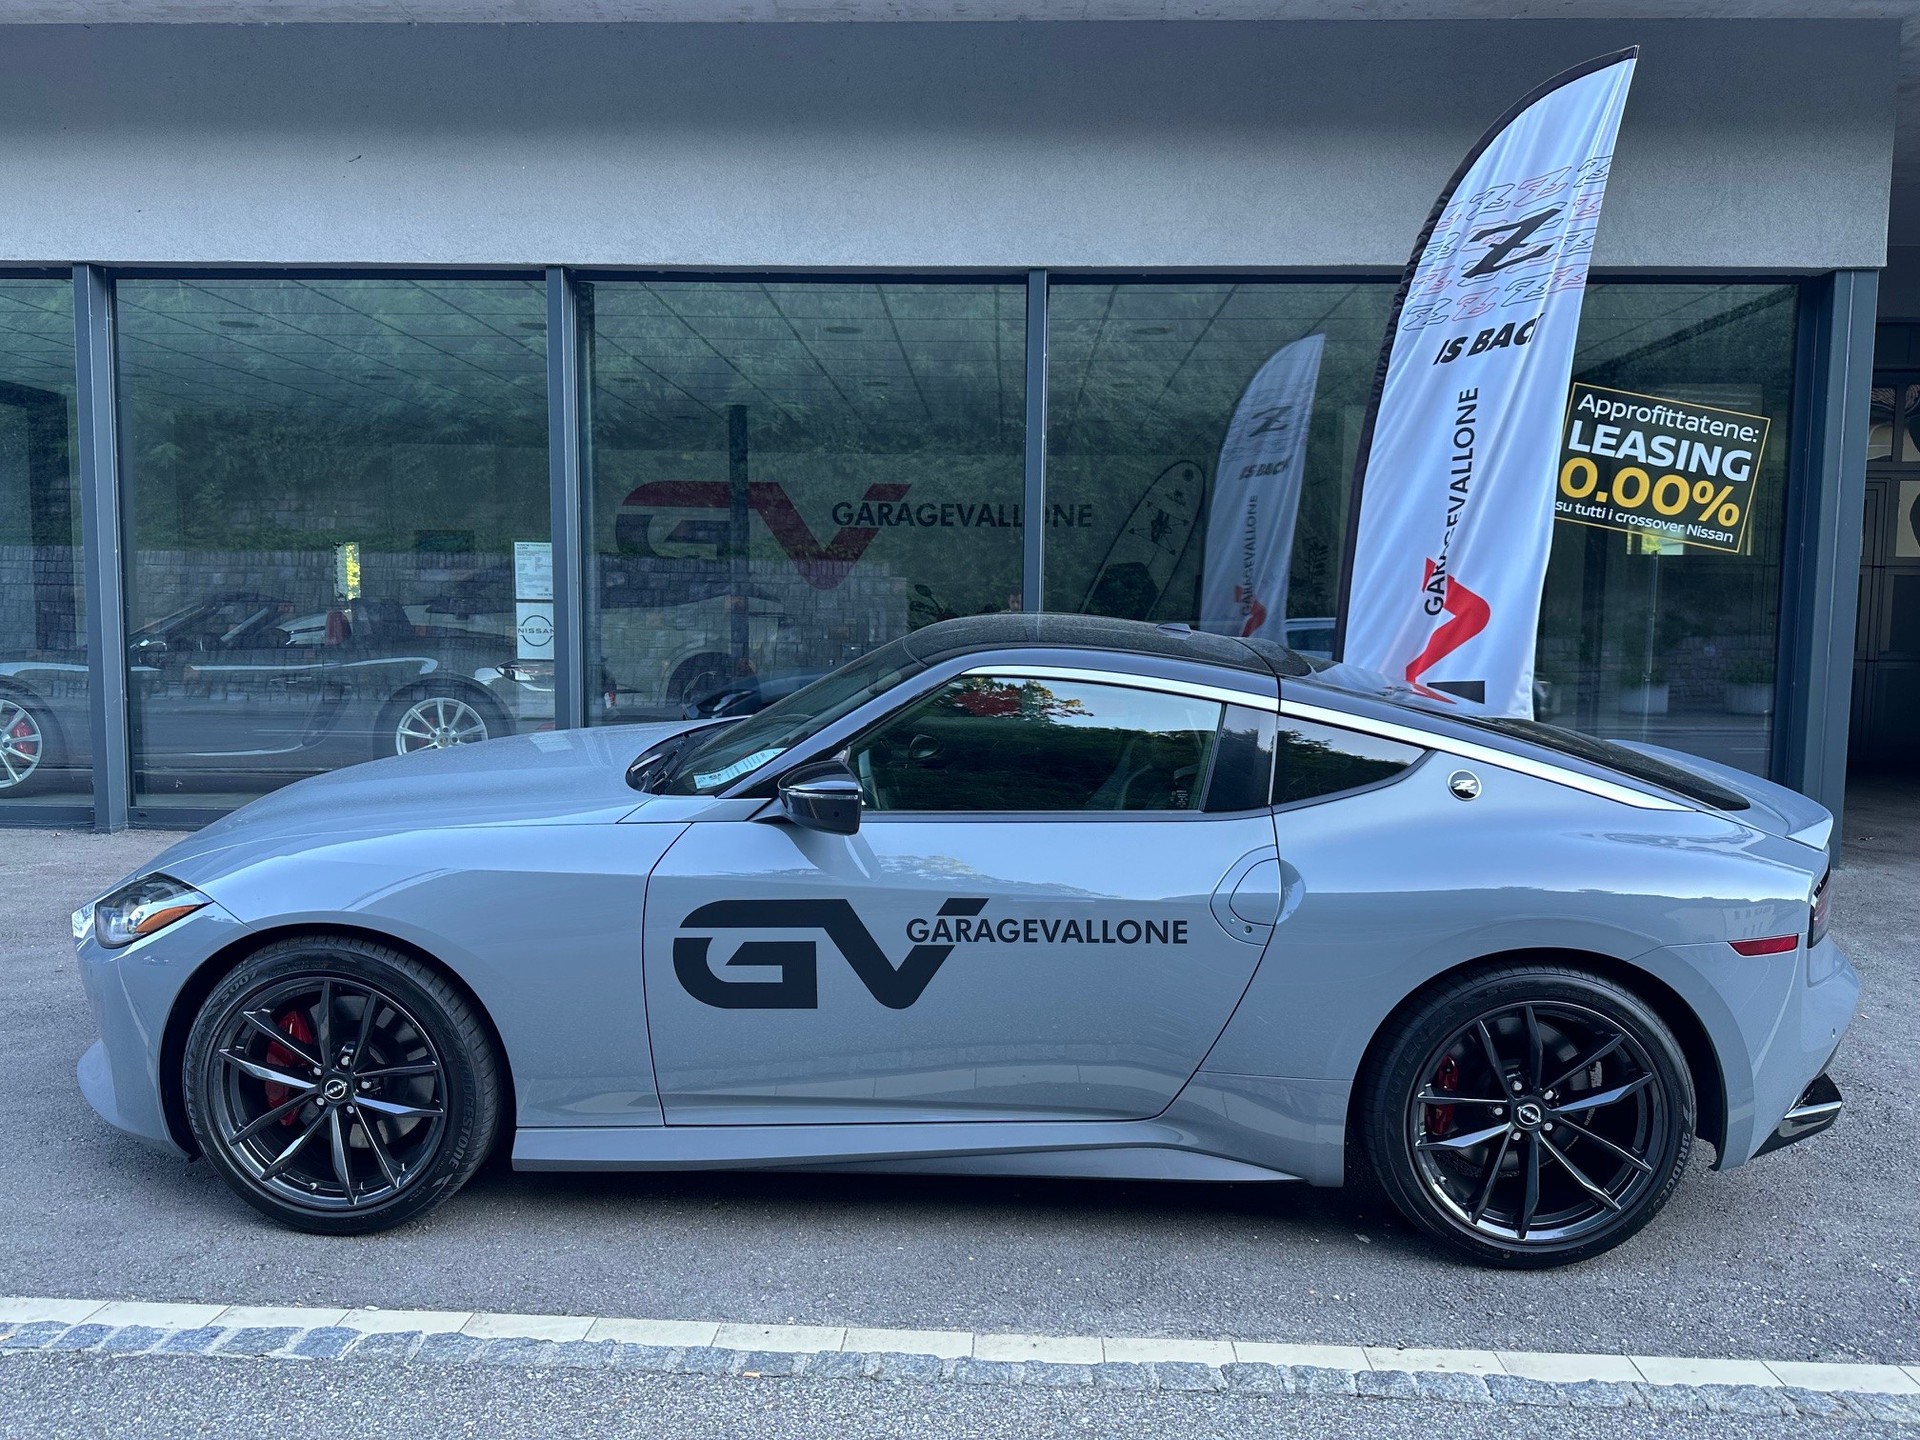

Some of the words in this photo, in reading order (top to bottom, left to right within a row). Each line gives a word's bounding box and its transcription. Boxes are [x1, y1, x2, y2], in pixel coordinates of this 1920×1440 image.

[1461, 208, 1563, 279] Z
[1433, 336, 1469, 365] IS
[1466, 312, 1545, 357] BAC
[1577, 393, 1760, 443] Approfittatene:
[1568, 419, 1752, 482] LEASING
[831, 501, 1092, 528] GARAGEVALLNE
[1424, 387, 1479, 616] GAREVALLONE
[1559, 457, 1740, 527] 0.00%
[1555, 500, 1573, 513] su
[1575, 503, 1606, 520] tutti
[1607, 508, 1614, 520] i
[1615, 511, 1685, 534] crossover
[1686, 523, 1734, 543] Nissan
[673, 897, 990, 1010] GV
[905, 917, 1188, 945] GARAGEVALLONE
